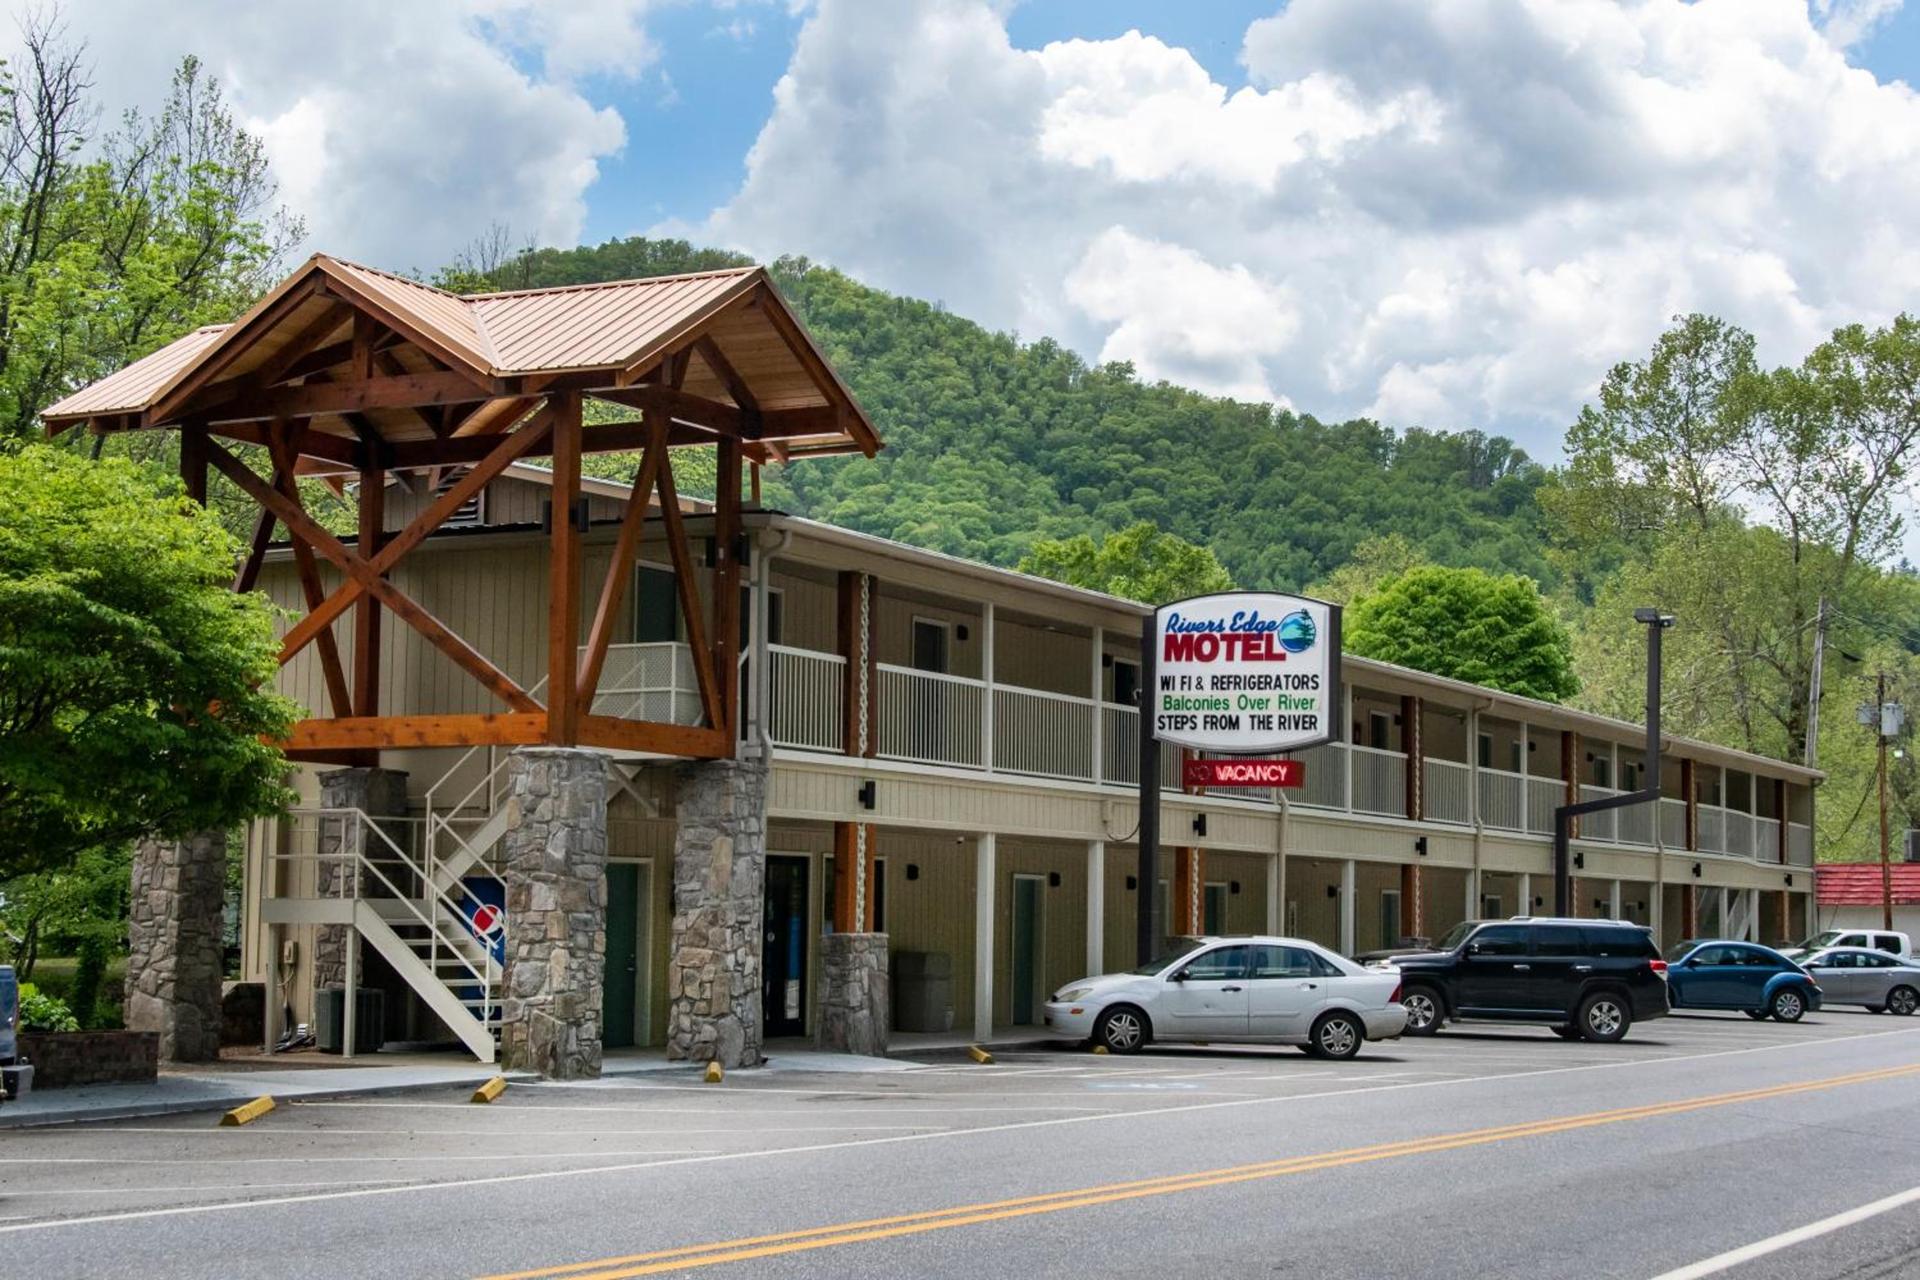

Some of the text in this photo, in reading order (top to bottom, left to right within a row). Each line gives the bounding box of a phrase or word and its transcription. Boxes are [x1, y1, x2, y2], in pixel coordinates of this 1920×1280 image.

[1166, 610, 1279, 636] Rivers Edge
[1164, 633, 1286, 662] MOTEL
[1195, 675, 1204, 691] &
[1211, 674, 1319, 691] REFRIGERATORS
[1163, 693, 1315, 711] Balconies Over River
[1158, 714, 1318, 731] STEPS FROM THE RIVER
[1215, 765, 1288, 781] VACANCY
